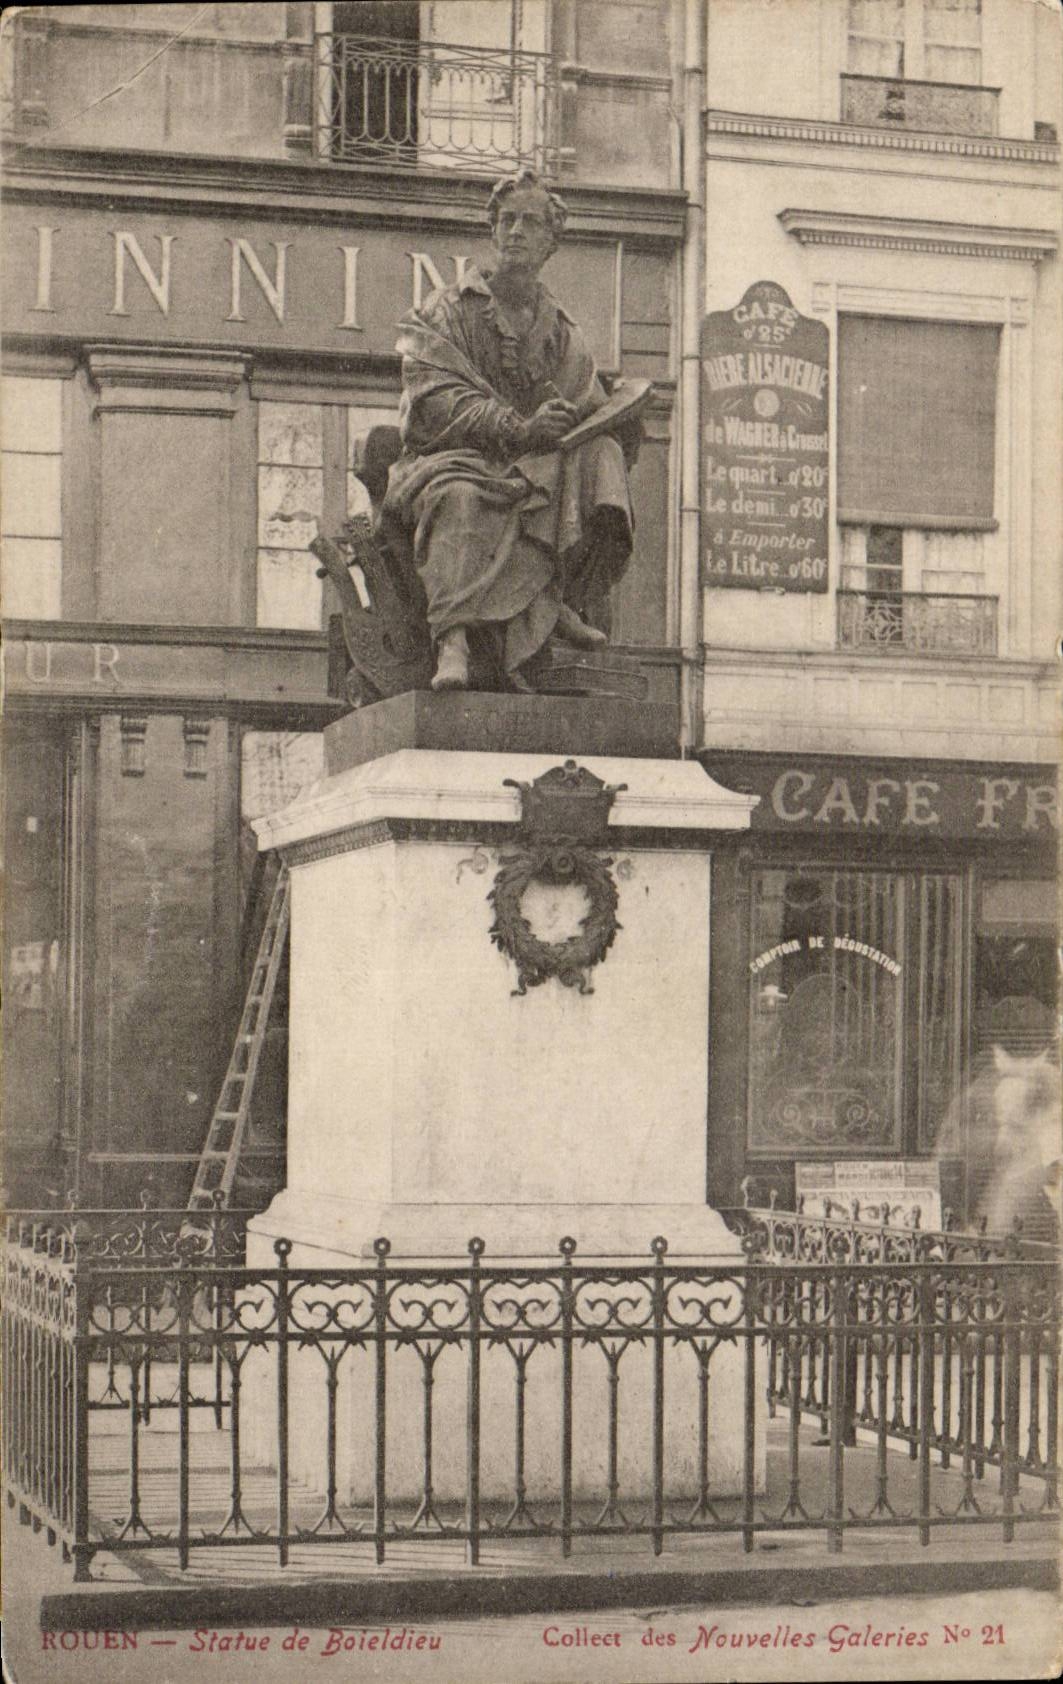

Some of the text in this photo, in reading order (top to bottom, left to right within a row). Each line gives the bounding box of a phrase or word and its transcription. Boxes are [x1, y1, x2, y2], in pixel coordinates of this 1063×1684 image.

[724, 416, 780, 449] WAGNER
[706, 455, 727, 481] Le
[705, 487, 727, 513] Le
[731, 490, 775, 517] demi
[729, 529, 816, 553] Emporter
[706, 550, 727, 574] Le
[731, 551, 780, 577] Litre
[750, 939, 801, 973] COMPTOIR
[808, 936, 825, 949] DE
